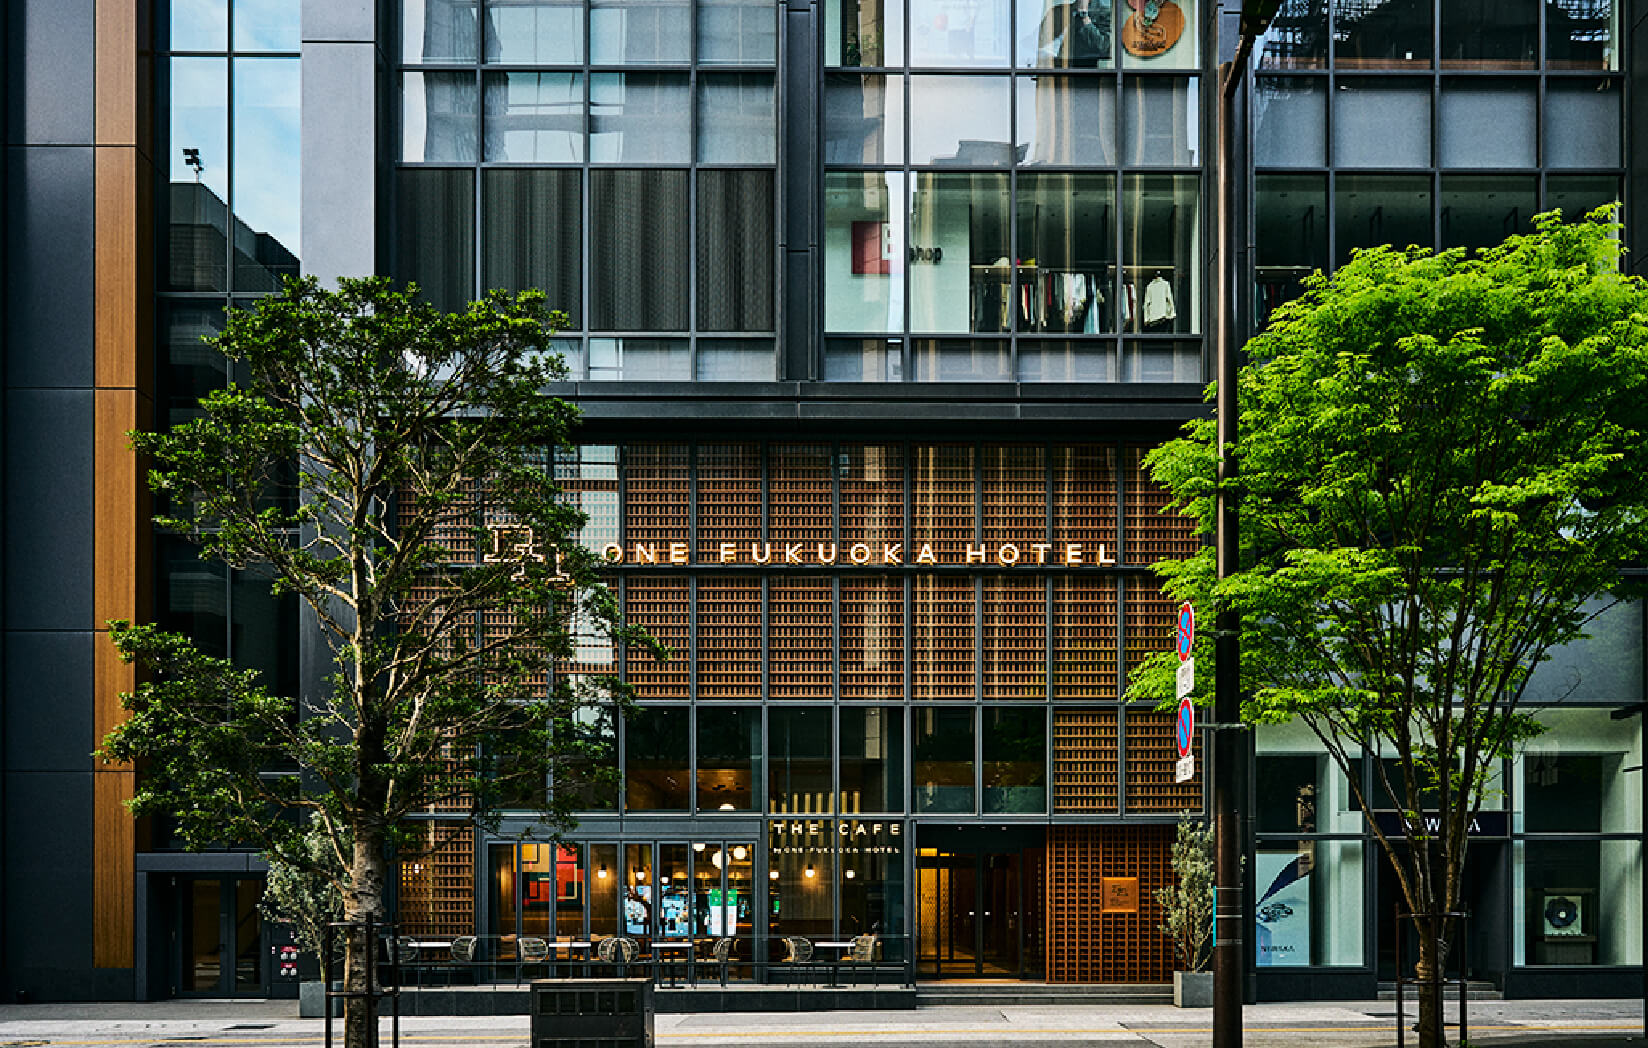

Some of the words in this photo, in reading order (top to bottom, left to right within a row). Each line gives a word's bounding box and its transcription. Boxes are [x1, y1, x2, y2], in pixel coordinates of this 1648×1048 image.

[601, 543, 689, 565] ONE
[720, 543, 937, 565] FUKUOKA
[966, 543, 1116, 565] HOTEL
[773, 823, 819, 836] THE
[838, 823, 901, 836] CAFE
